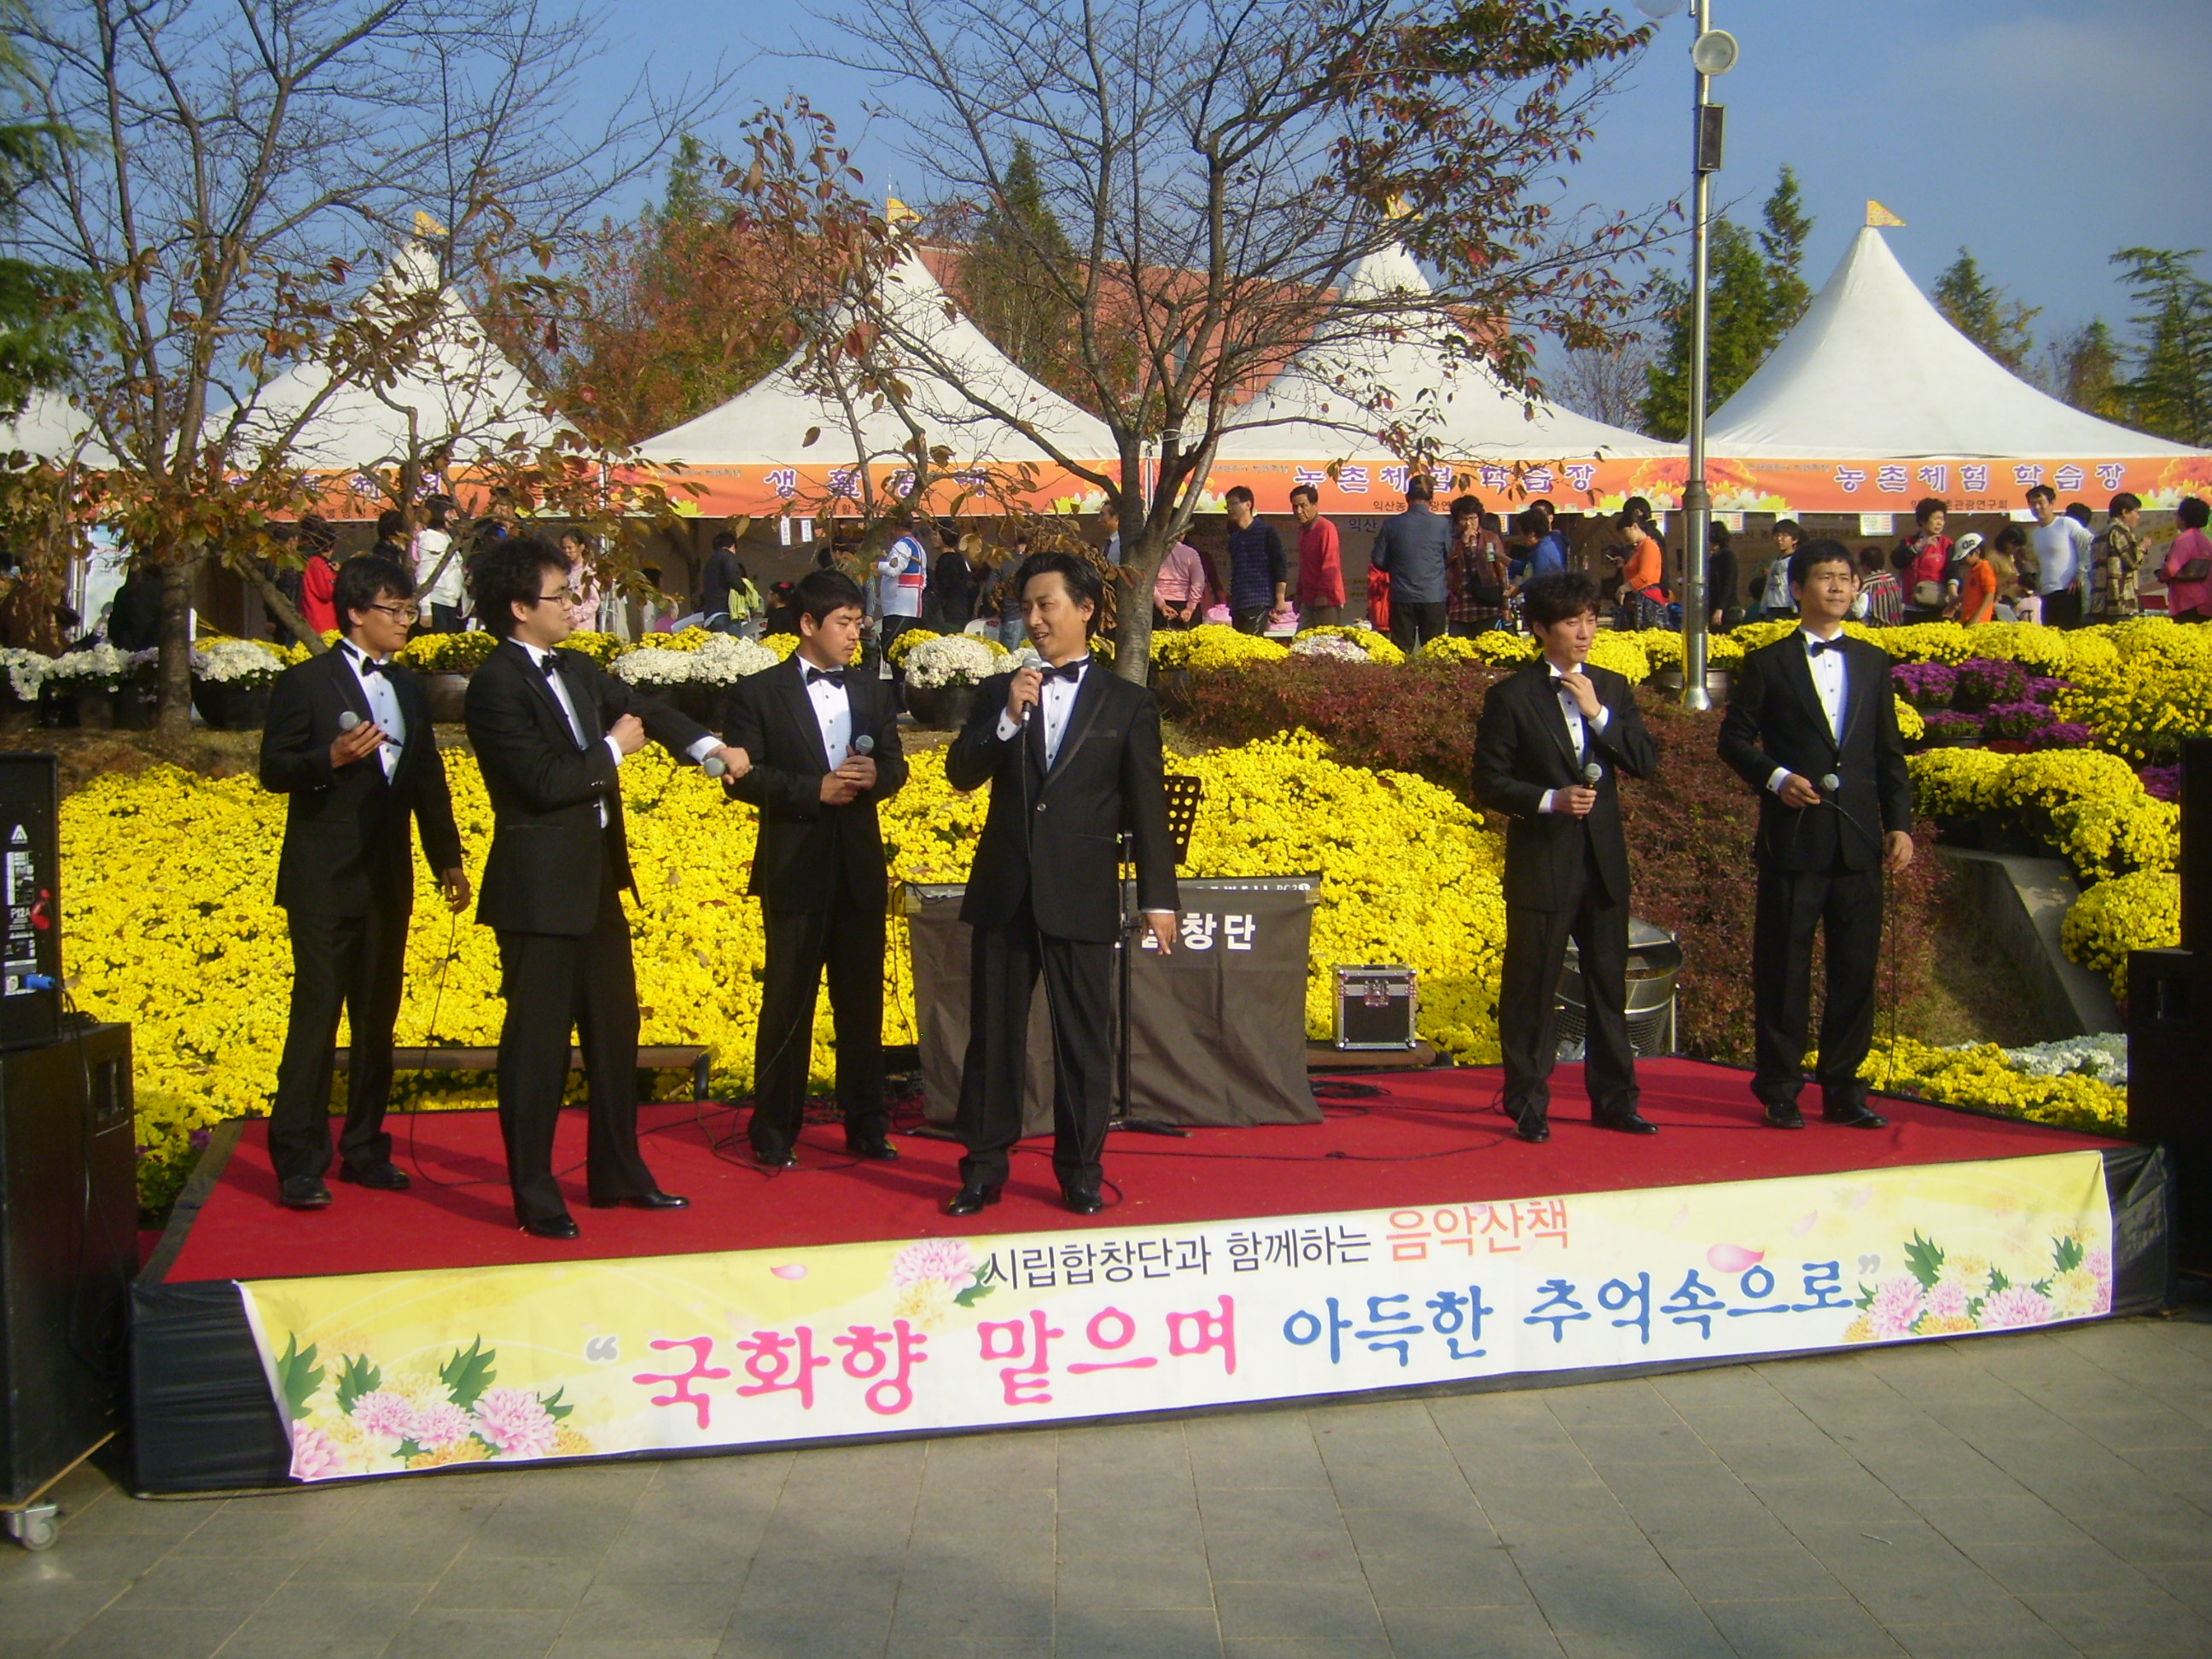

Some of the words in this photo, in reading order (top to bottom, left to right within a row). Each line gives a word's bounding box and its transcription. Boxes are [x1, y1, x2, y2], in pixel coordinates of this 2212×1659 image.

[1834, 464, 1988, 492] 농촌체험
[2013, 463, 2125, 492] 학습장
[983, 1234, 1212, 1290] 시립합창단과
[1225, 1225, 1372, 1273] 함께하는
[1385, 1198, 1569, 1262] 음악산책
[977, 1295, 1237, 1406] 맡으며
[1283, 1285, 1495, 1367] 아득한
